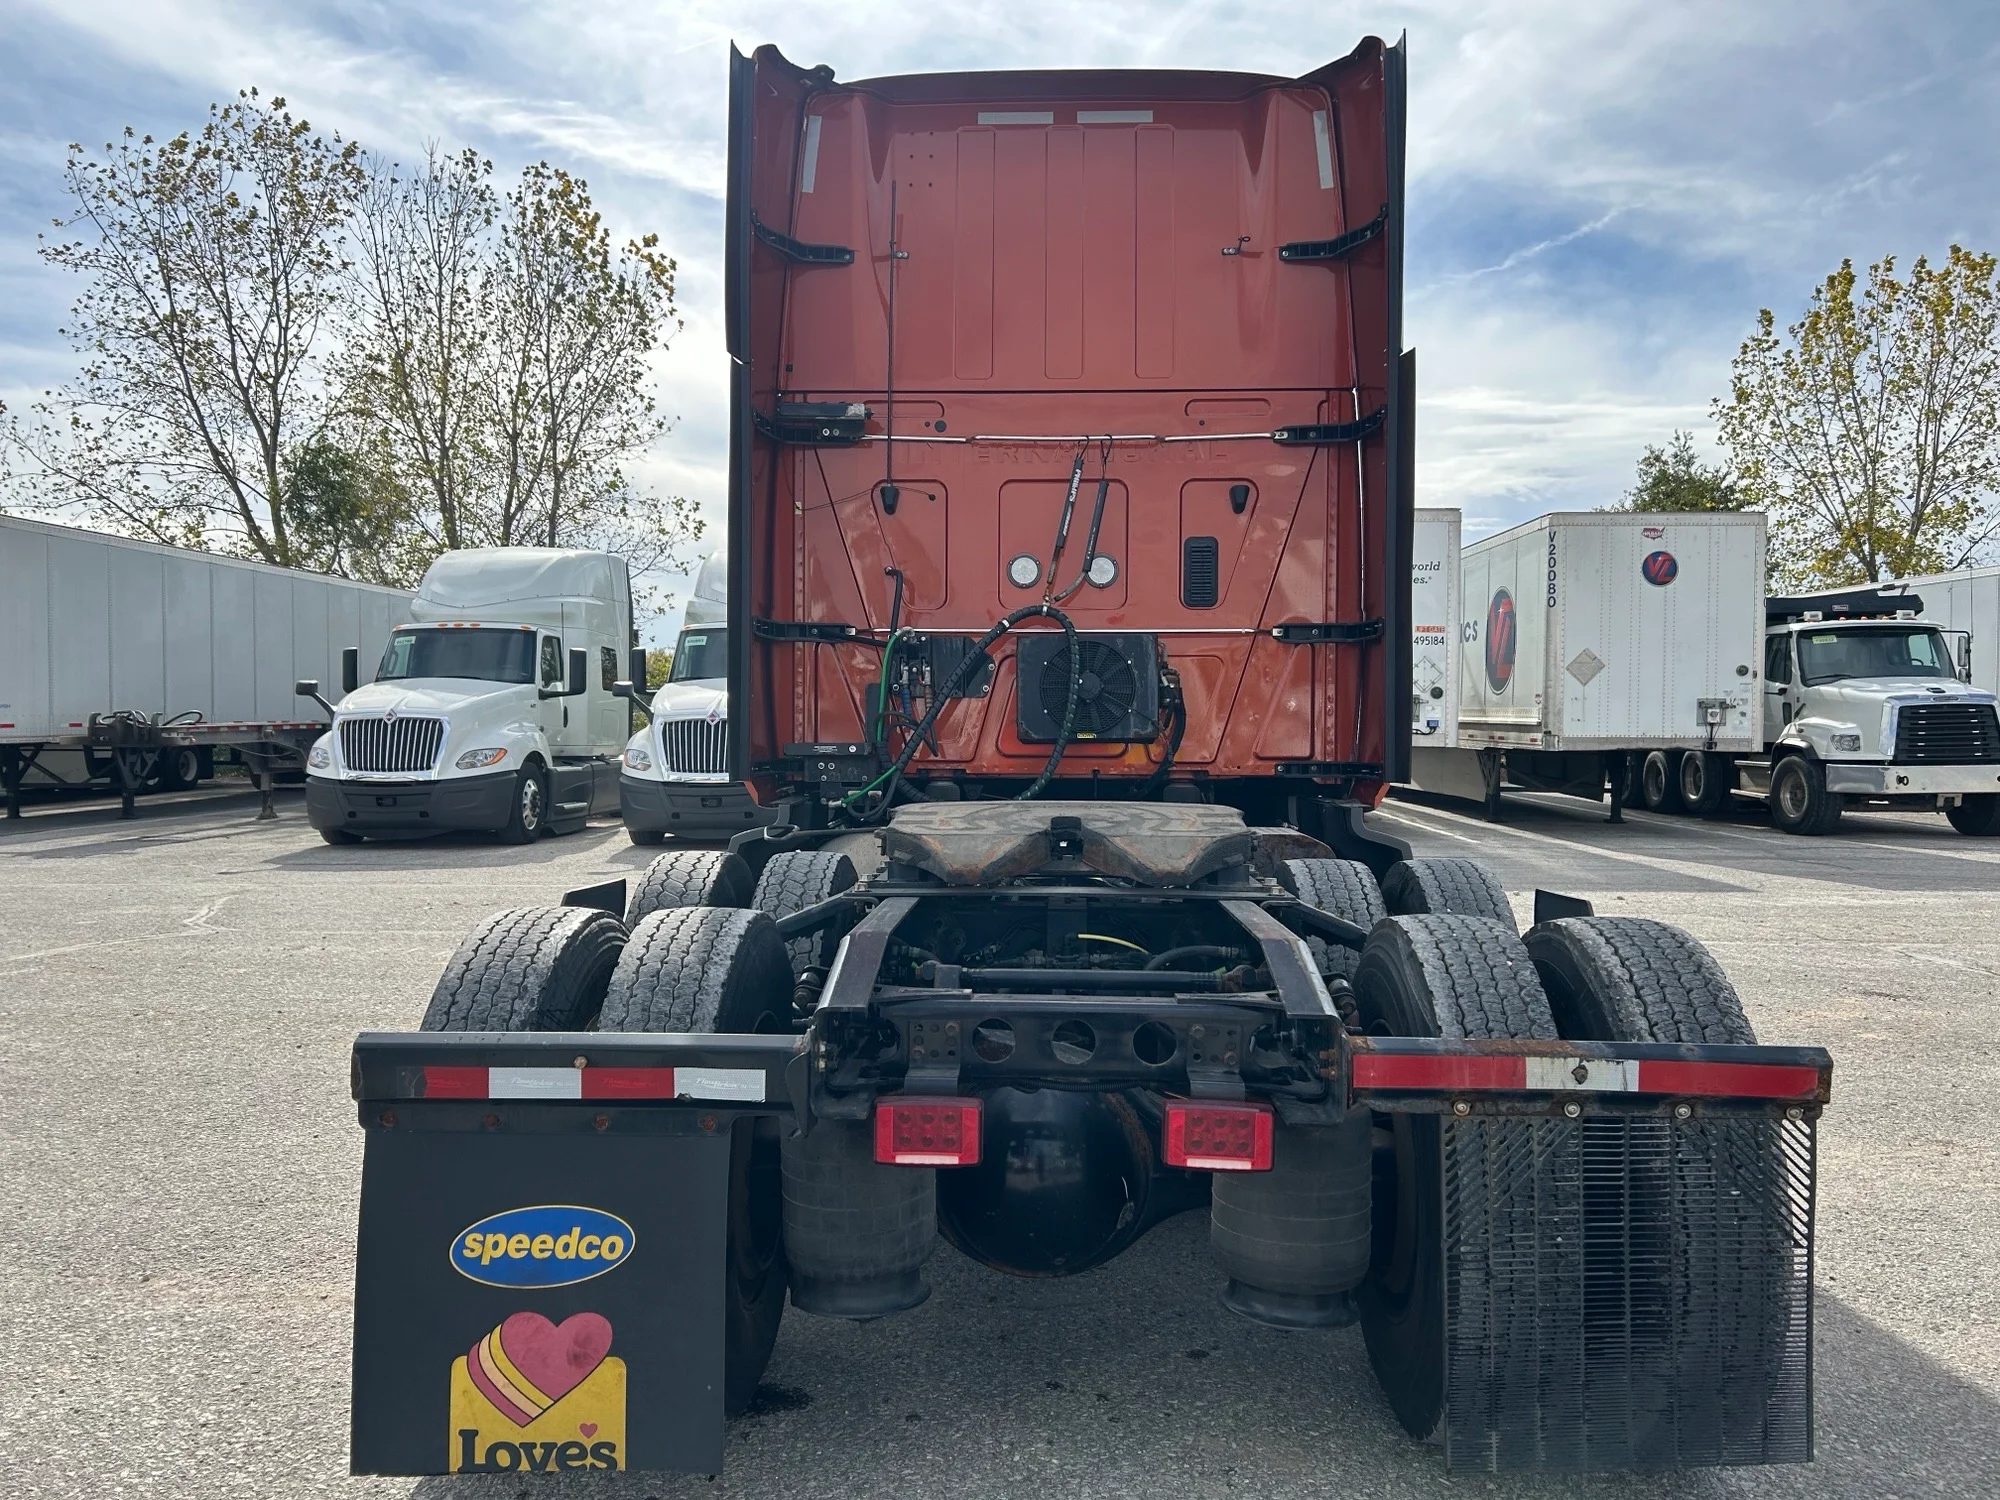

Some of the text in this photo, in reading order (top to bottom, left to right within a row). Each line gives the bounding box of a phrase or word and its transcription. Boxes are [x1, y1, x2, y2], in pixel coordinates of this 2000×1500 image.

[1547, 531, 1557, 608] V20080
[1413, 636, 1445, 646] 495184
[462, 1226, 625, 1266] speedco
